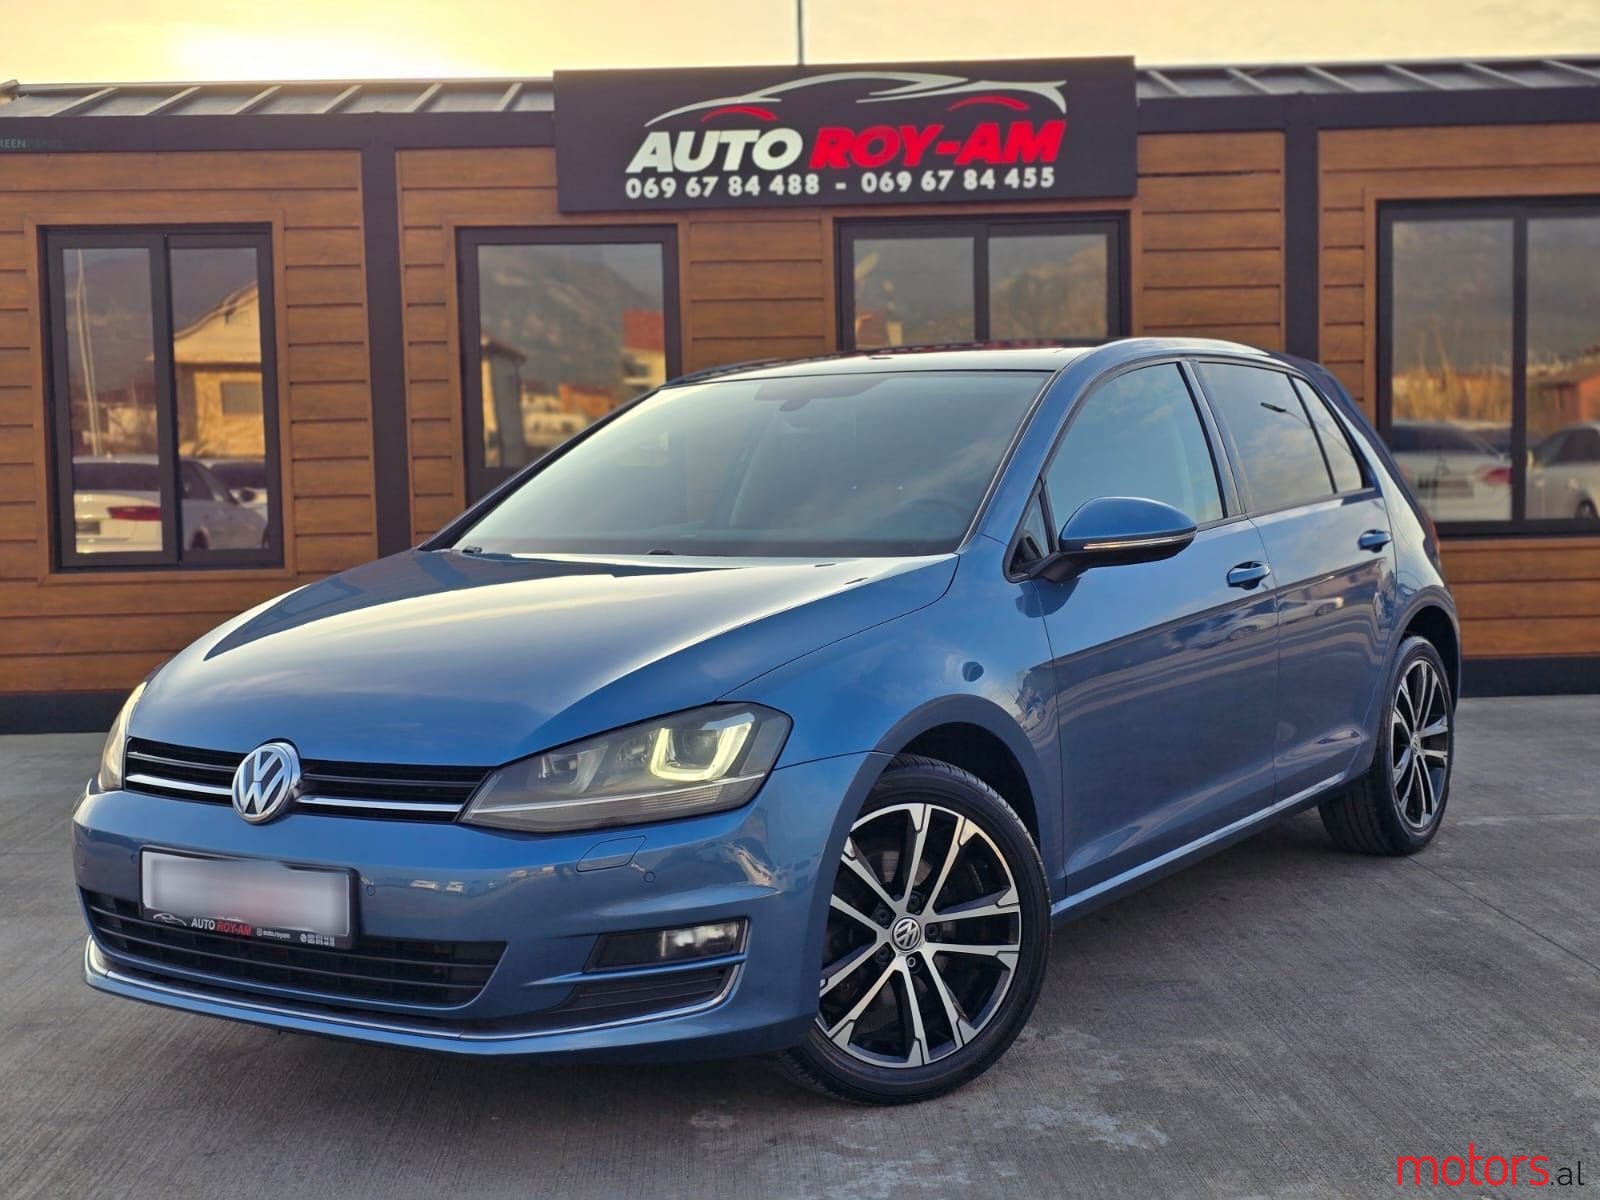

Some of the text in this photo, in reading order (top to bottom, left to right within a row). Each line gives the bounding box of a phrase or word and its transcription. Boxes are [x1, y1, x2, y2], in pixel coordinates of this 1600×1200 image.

[625, 119, 1067, 174] AUTO ROY-AM
[625, 177, 677, 199] 069
[685, 176, 719, 198] 67
[728, 175, 761, 197] 84
[769, 173, 820, 196] 488
[861, 171, 912, 193] 069
[920, 169, 954, 191] 67
[963, 168, 996, 190] 84
[1004, 166, 1055, 189] 455
[191, 917, 216, 931] AUTO
[216, 920, 252, 937] ROY-AM
